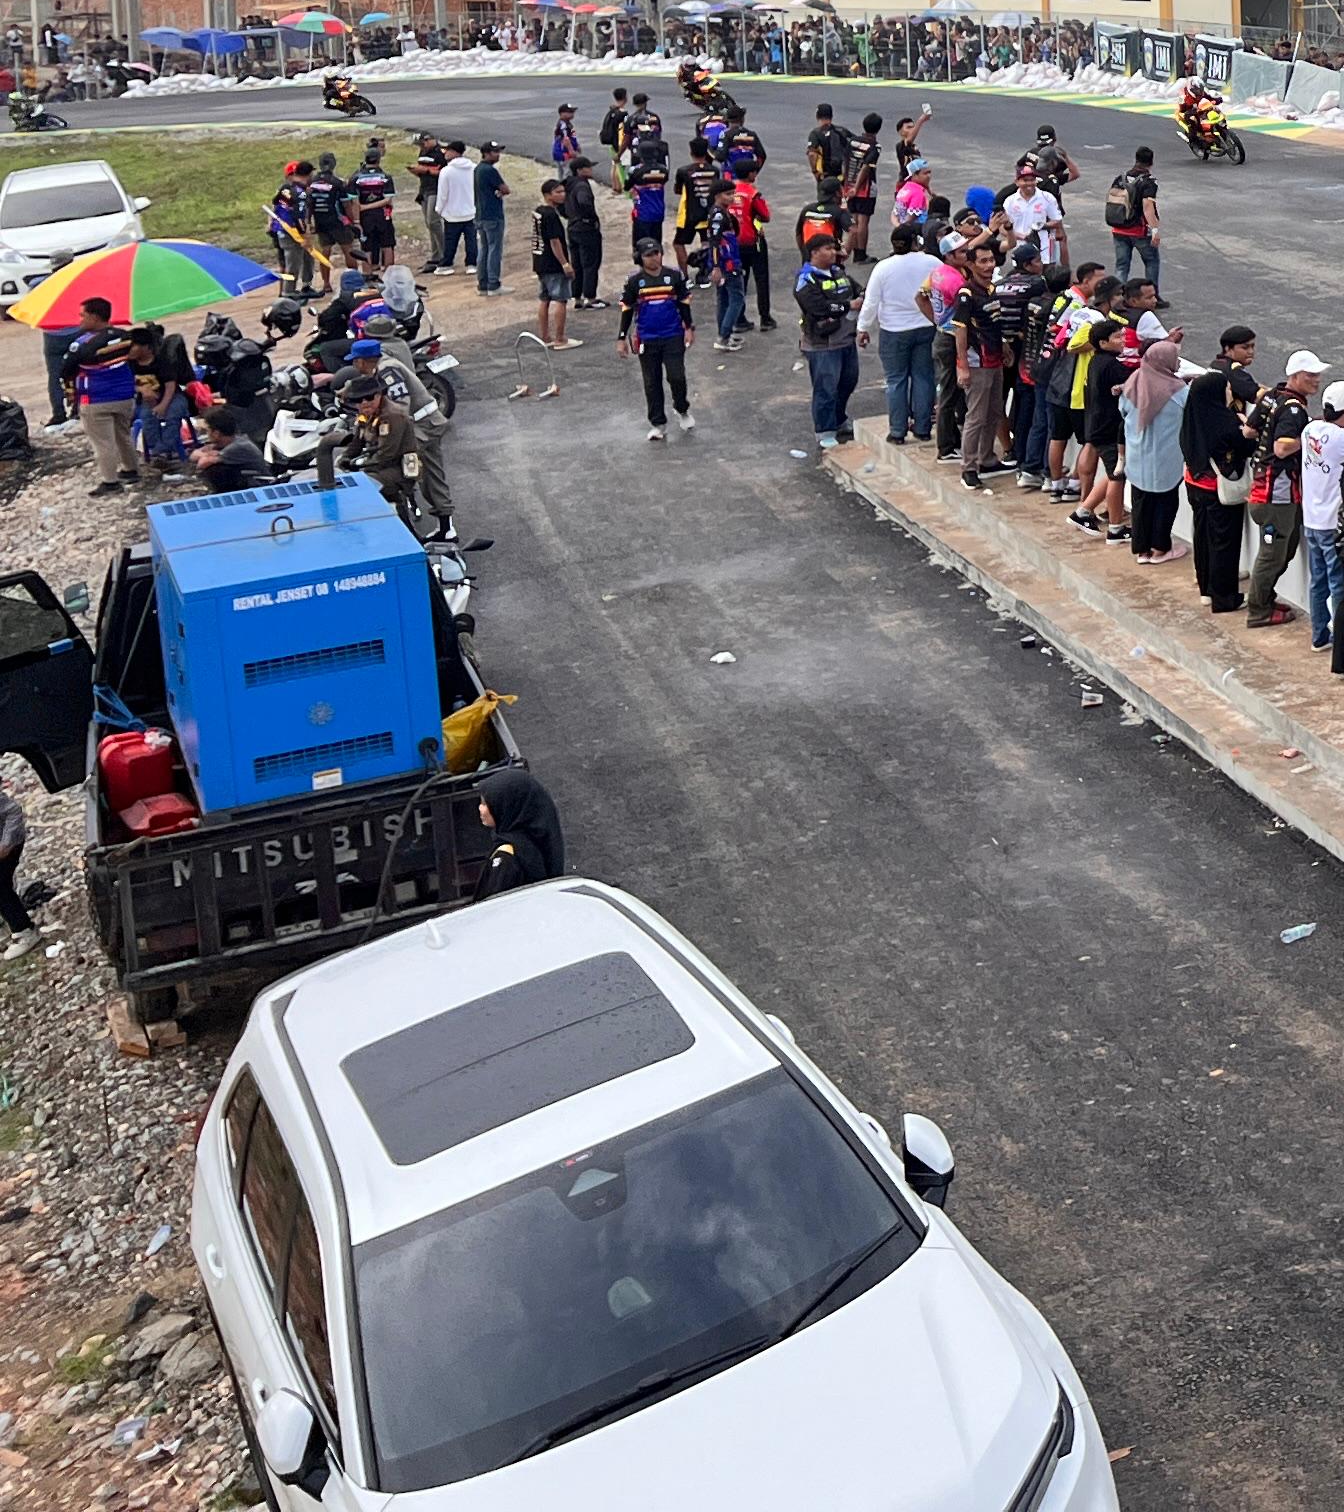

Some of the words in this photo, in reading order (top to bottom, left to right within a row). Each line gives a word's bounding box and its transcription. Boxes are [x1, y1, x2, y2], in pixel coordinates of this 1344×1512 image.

[233, 593, 274, 611] RENTAL
[275, 585, 314, 604] JENSET
[172, 808, 434, 888] MITSUBISH
